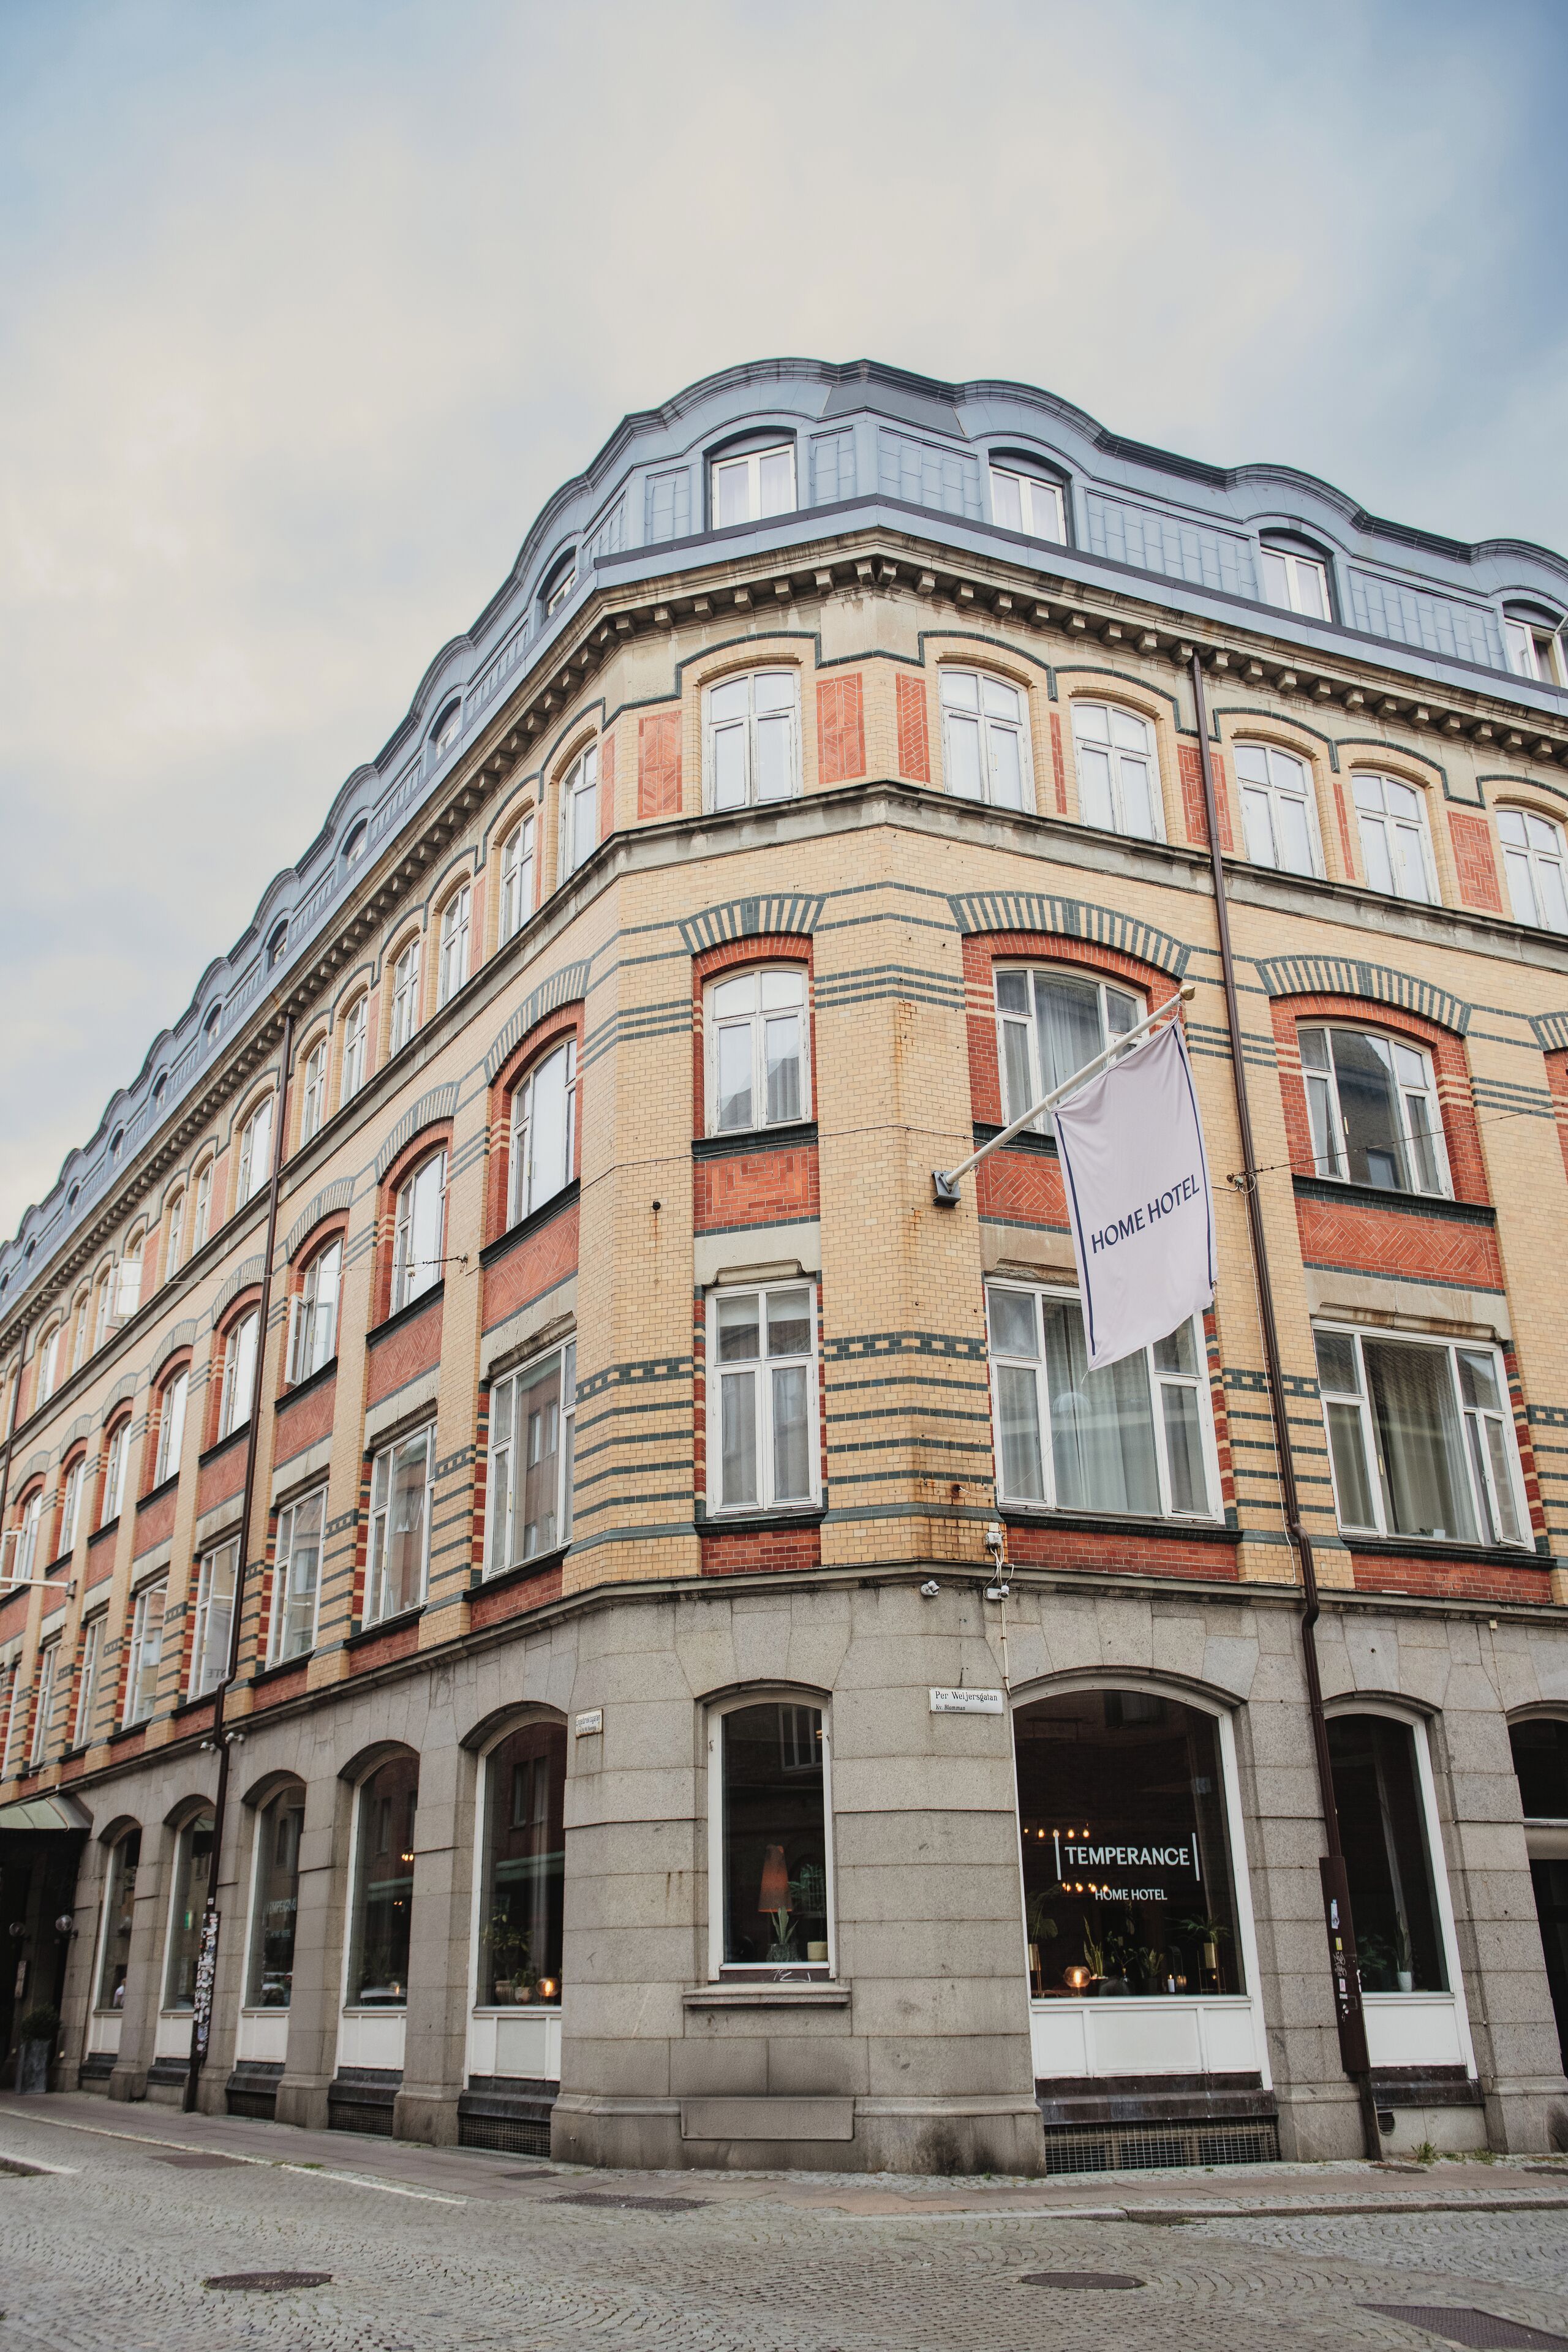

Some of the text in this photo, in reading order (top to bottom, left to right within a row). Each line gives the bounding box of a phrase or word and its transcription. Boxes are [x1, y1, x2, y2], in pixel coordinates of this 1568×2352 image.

[1091, 1174, 1200, 1254] HOME HOTEL
[935, 1691, 998, 1702] Per Weijersgatan
[1065, 1847, 1190, 1866] TEMPERANCE
[1095, 1889, 1167, 1901] HOME HOTEL
